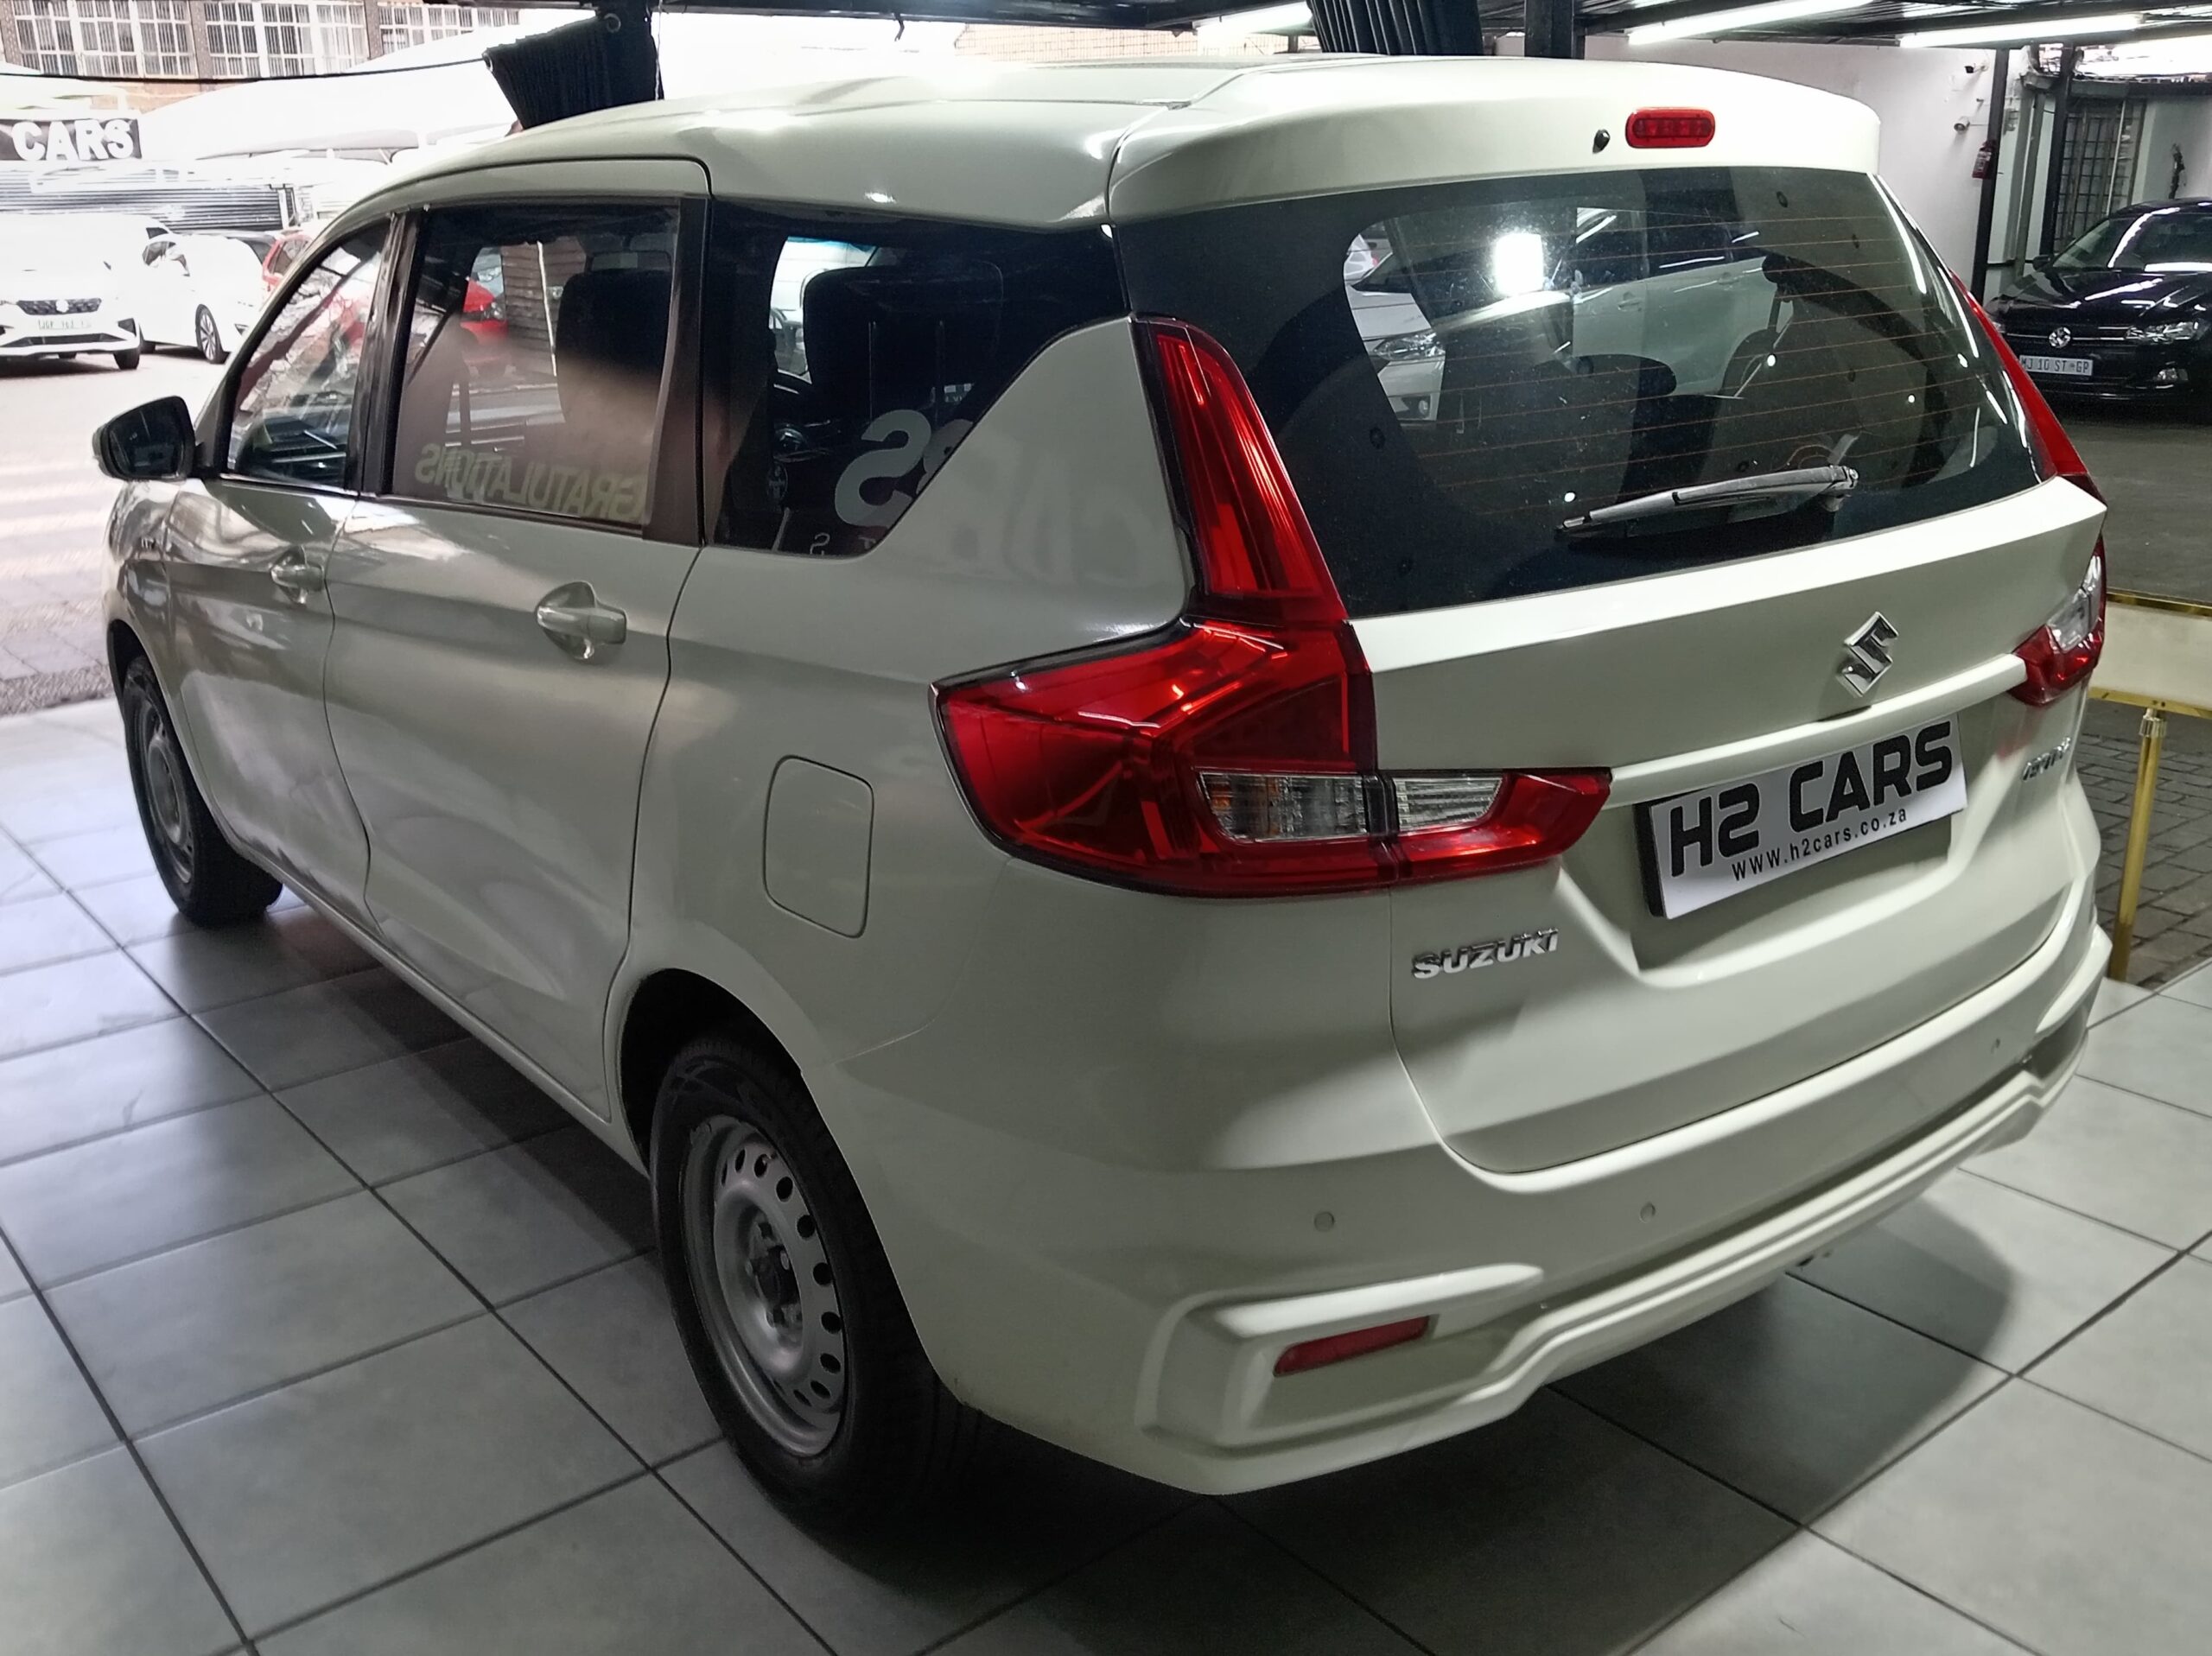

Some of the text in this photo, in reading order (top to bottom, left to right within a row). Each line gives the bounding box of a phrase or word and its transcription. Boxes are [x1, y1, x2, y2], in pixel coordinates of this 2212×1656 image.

[11, 118, 134, 162] CARS
[2054, 359, 2068, 371] ST
[2075, 360, 2090, 373] GP
[1669, 783, 1760, 878] H2
[1788, 720, 1953, 834] CARS
[1731, 806, 1908, 882] www.h2cars.co.za
[1412, 928, 1559, 979] SUZUKI
